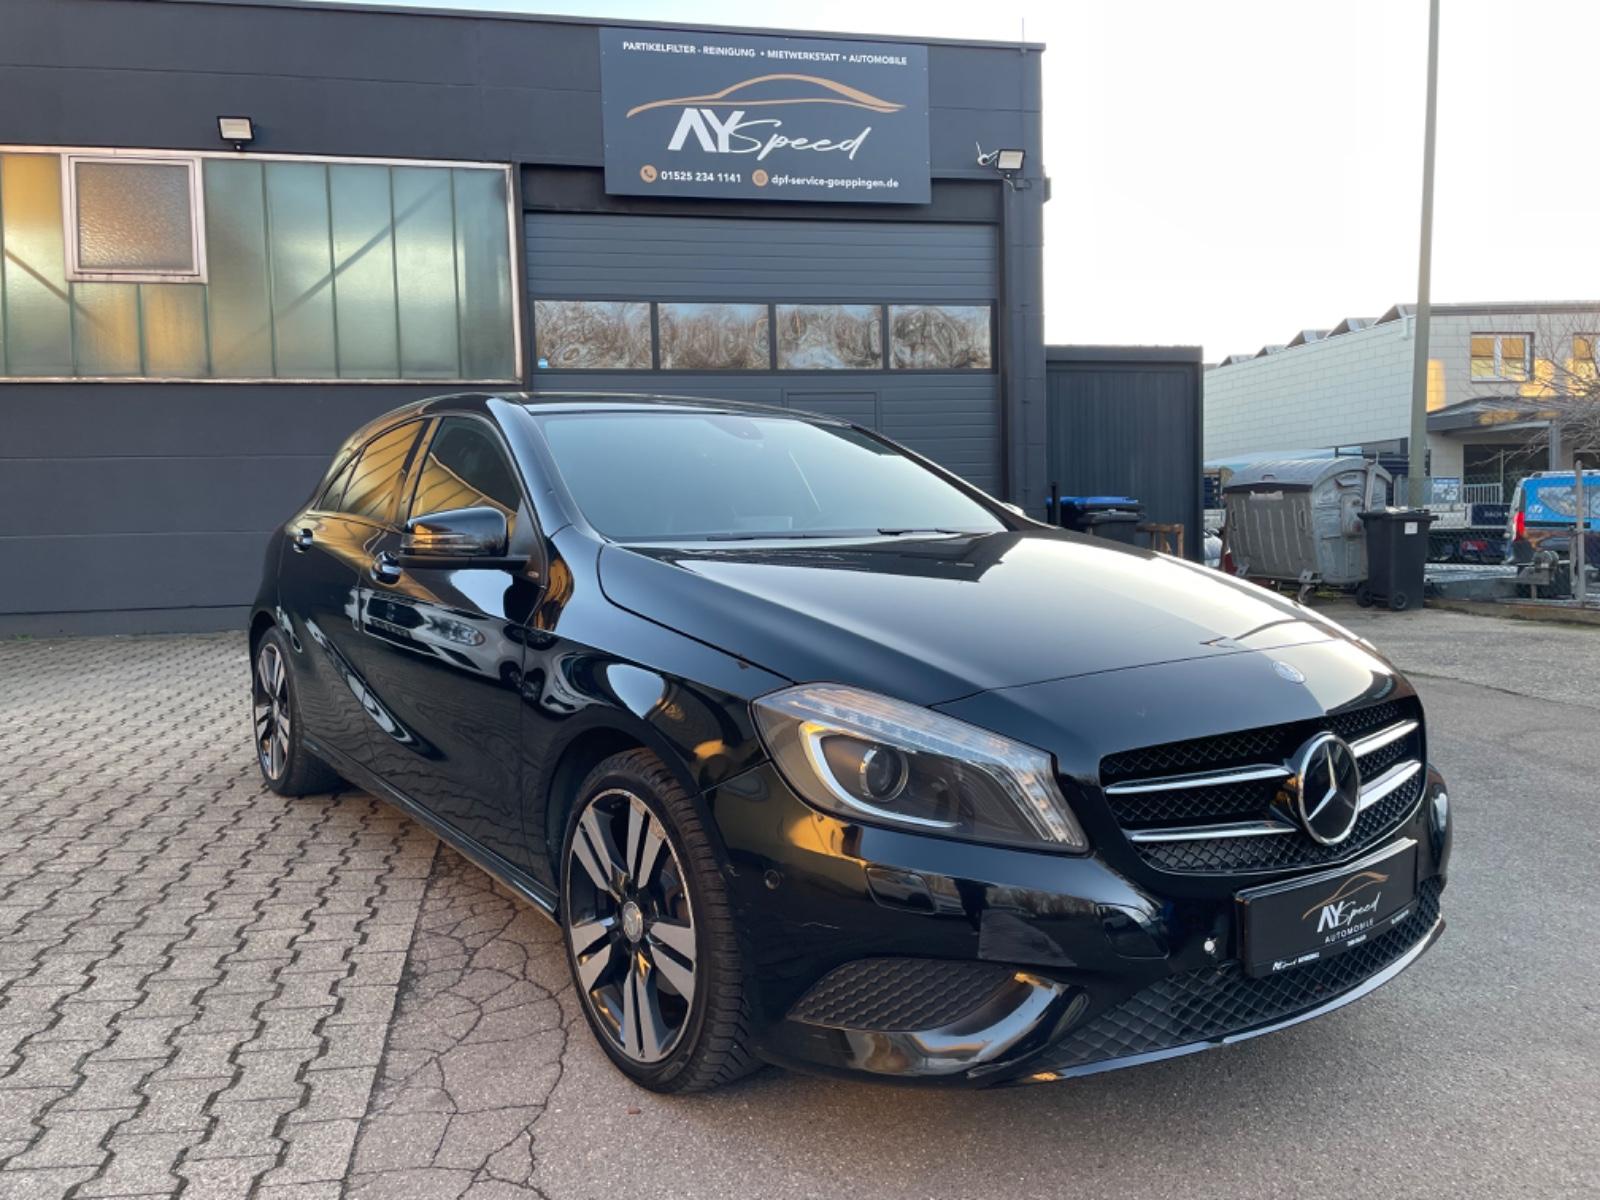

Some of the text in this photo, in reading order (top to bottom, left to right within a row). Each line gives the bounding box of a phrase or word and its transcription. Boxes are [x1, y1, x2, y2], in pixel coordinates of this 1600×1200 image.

[623, 41, 908, 65] PARTIKELFILTER REINIGUNG MIETWERKSTATT AUTOMOBILE
[661, 170, 741, 183] 01525 234 1141
[771, 174, 899, 190] dpf-service-goeppingen.de
